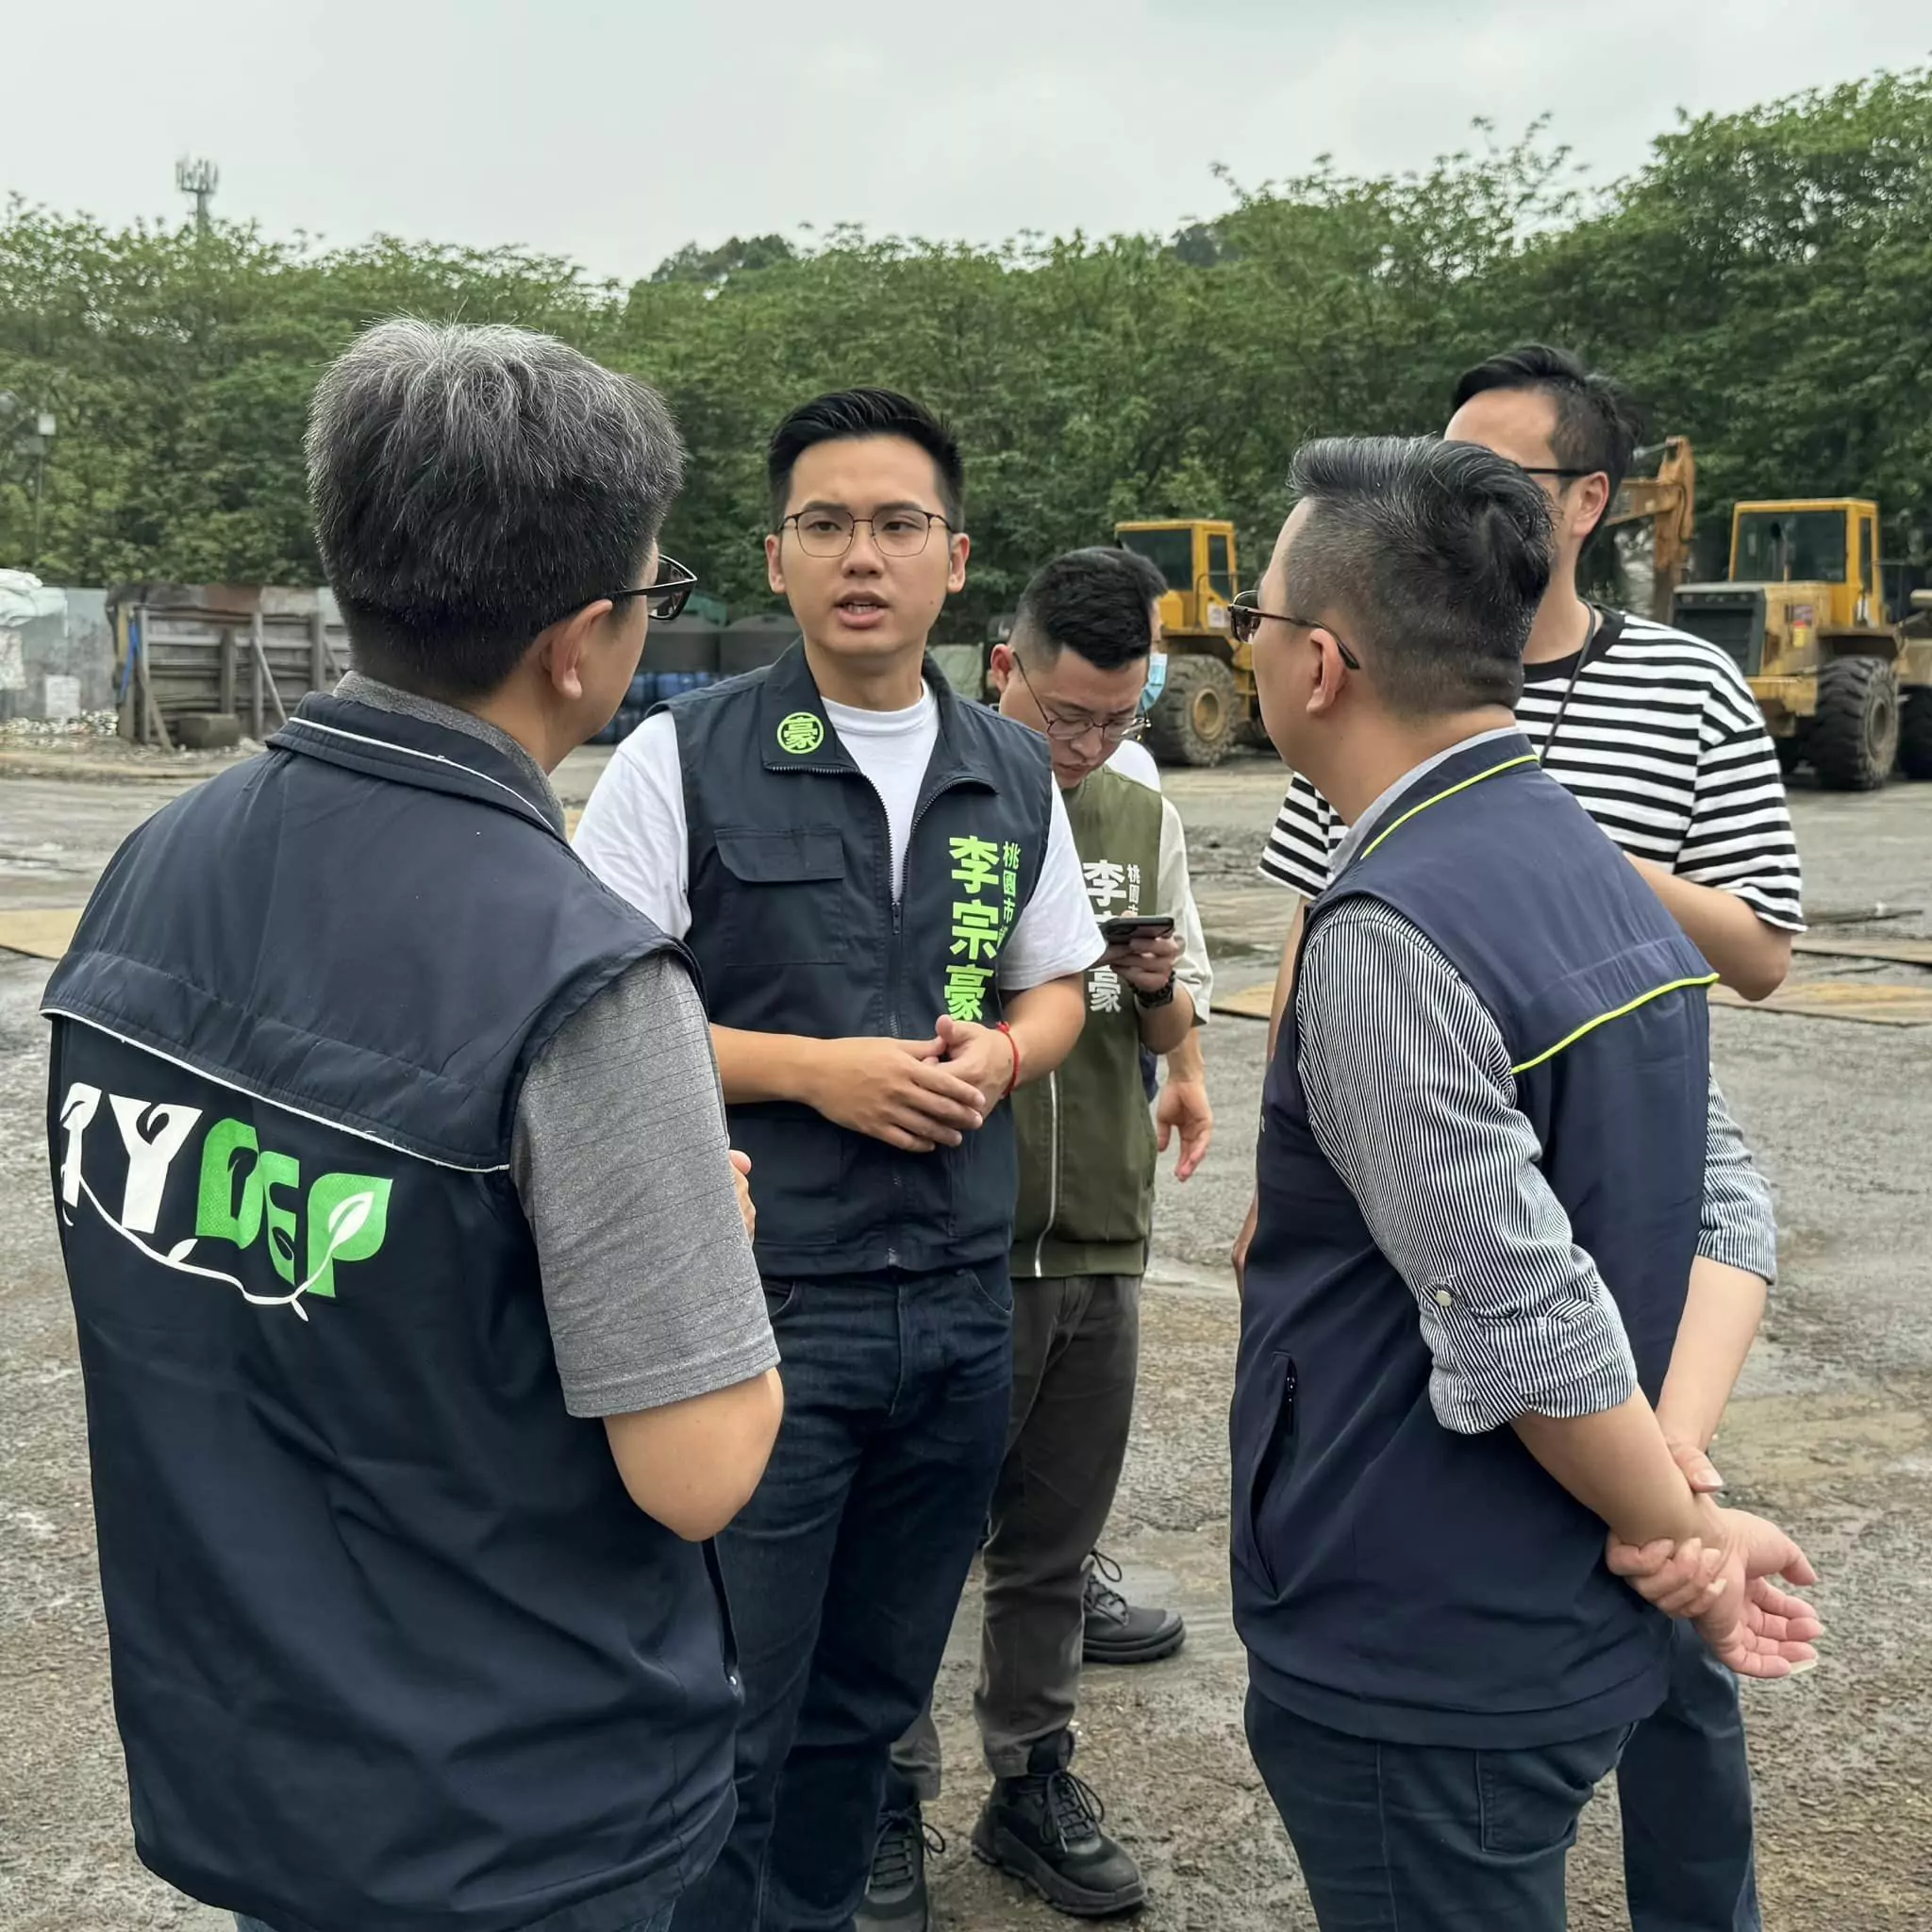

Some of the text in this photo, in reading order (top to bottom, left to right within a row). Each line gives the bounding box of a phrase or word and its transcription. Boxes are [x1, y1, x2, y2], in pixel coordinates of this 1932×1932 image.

[781, 715, 820, 751] 豪
[944, 835, 999, 1021] 李宗豪
[1082, 859, 1127, 1012] 李豪
